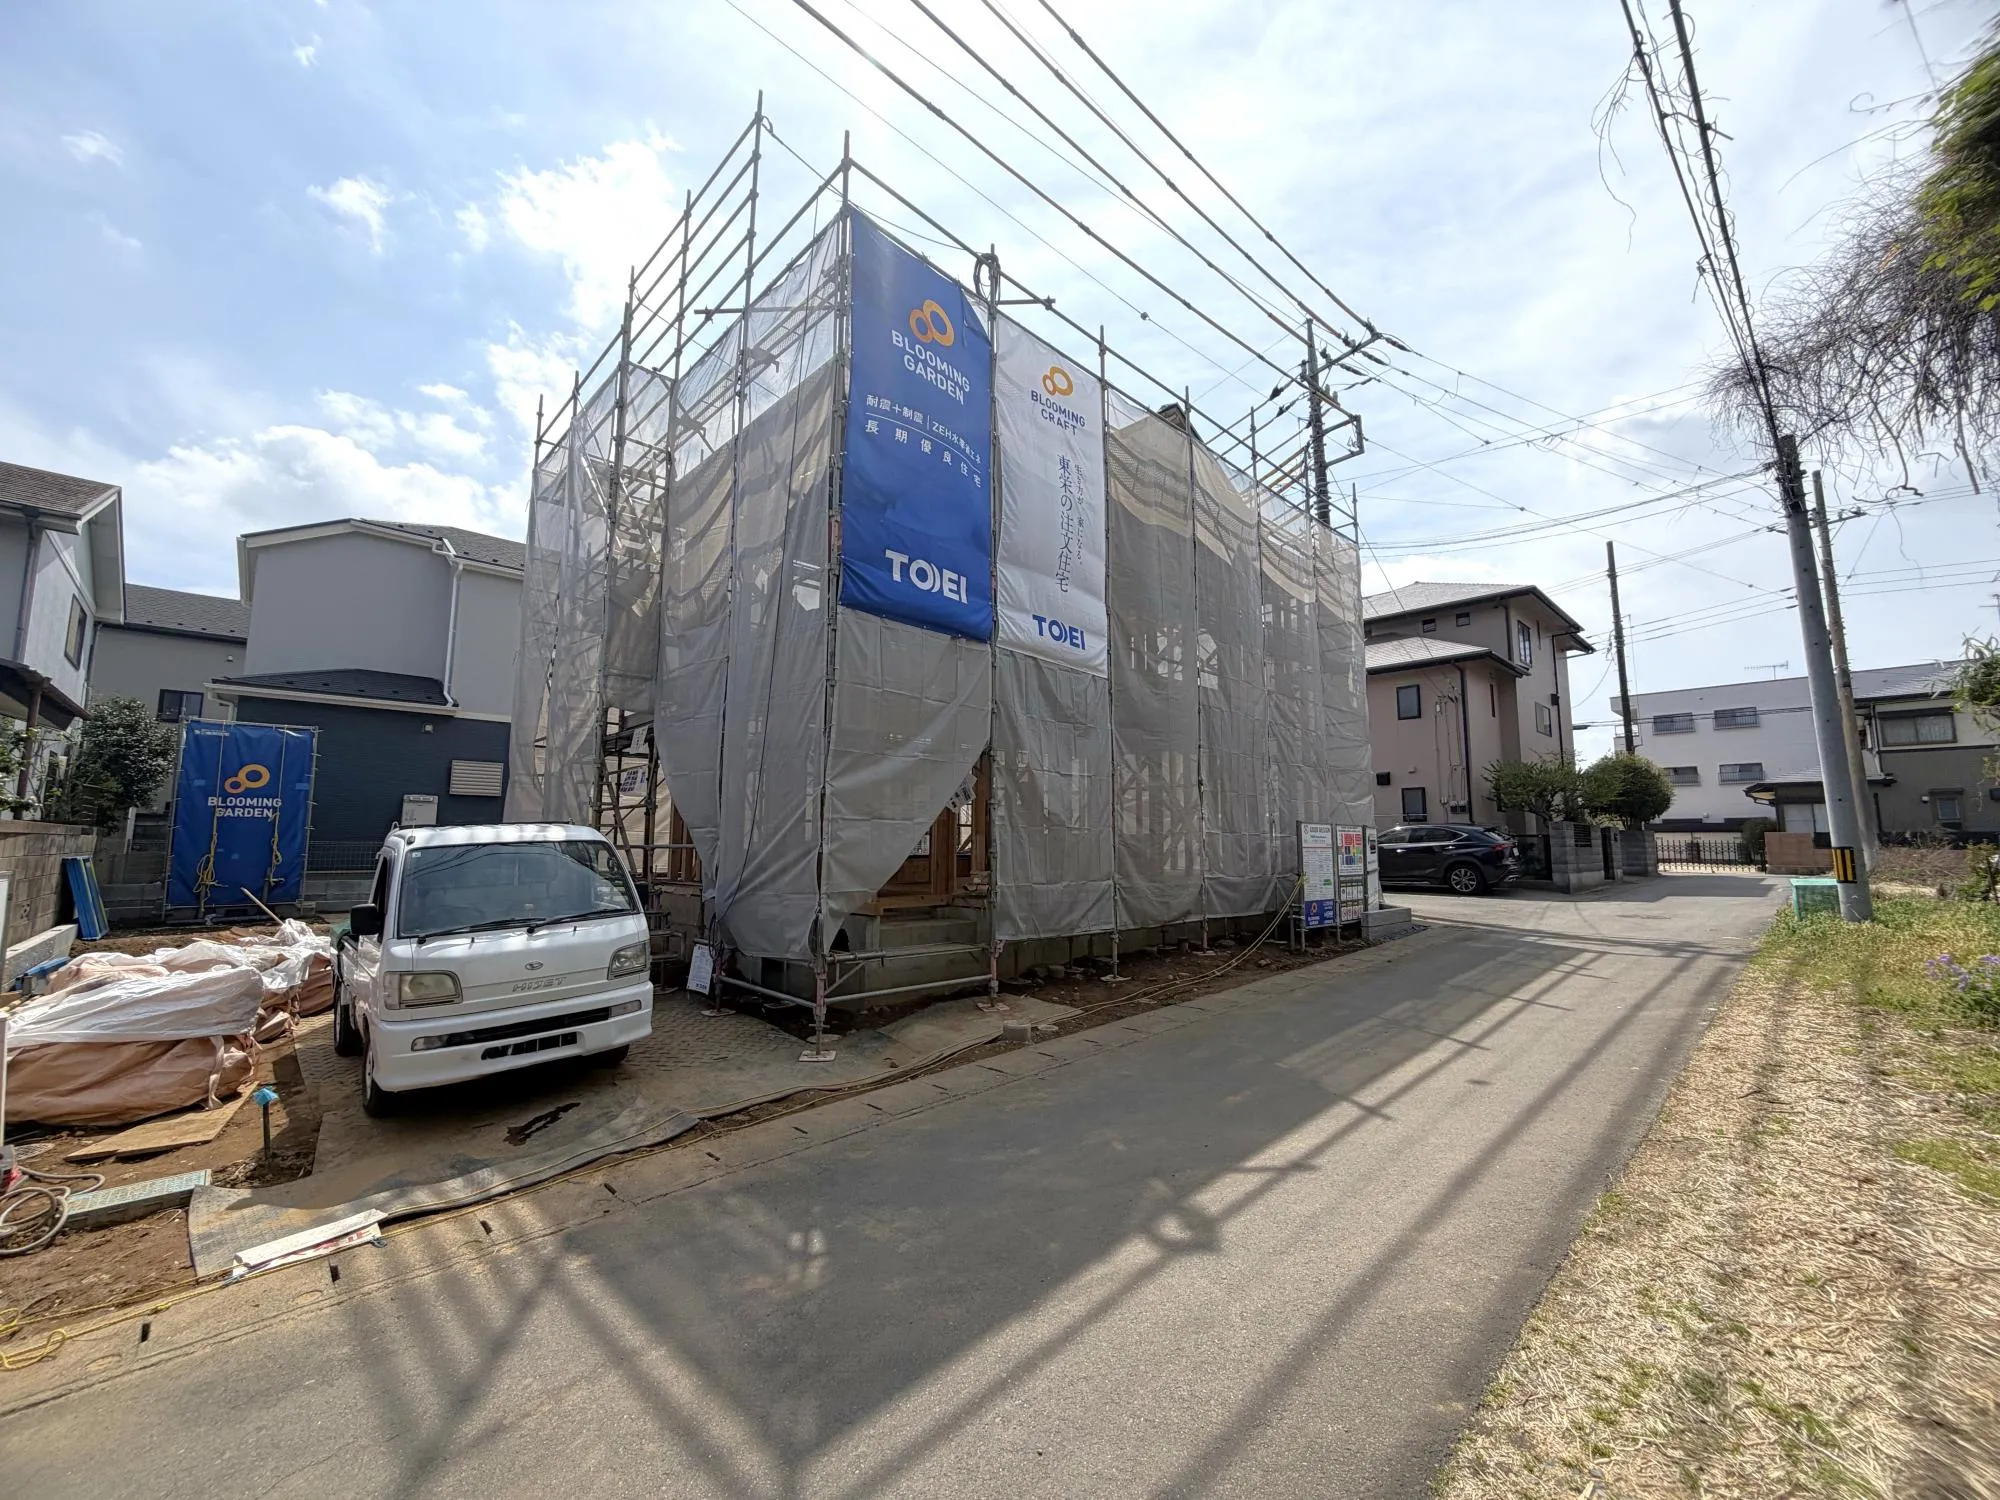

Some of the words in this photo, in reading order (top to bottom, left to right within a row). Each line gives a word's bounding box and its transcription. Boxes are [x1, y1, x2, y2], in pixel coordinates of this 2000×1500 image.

[891, 329, 970, 392] BLOOMING
[903, 354, 965, 406] GARDEN
[1030, 389, 1086, 428] BLOOMING
[1040, 408, 1078, 436] CRAFT
[864, 419, 982, 488] 長期優良住宅
[1056, 453, 1074, 593] 東栄の注文住宅
[207, 796, 282, 807] BLOOMING
[215, 807, 273, 818] GARDEN
[512, 976, 567, 992] HIJET
